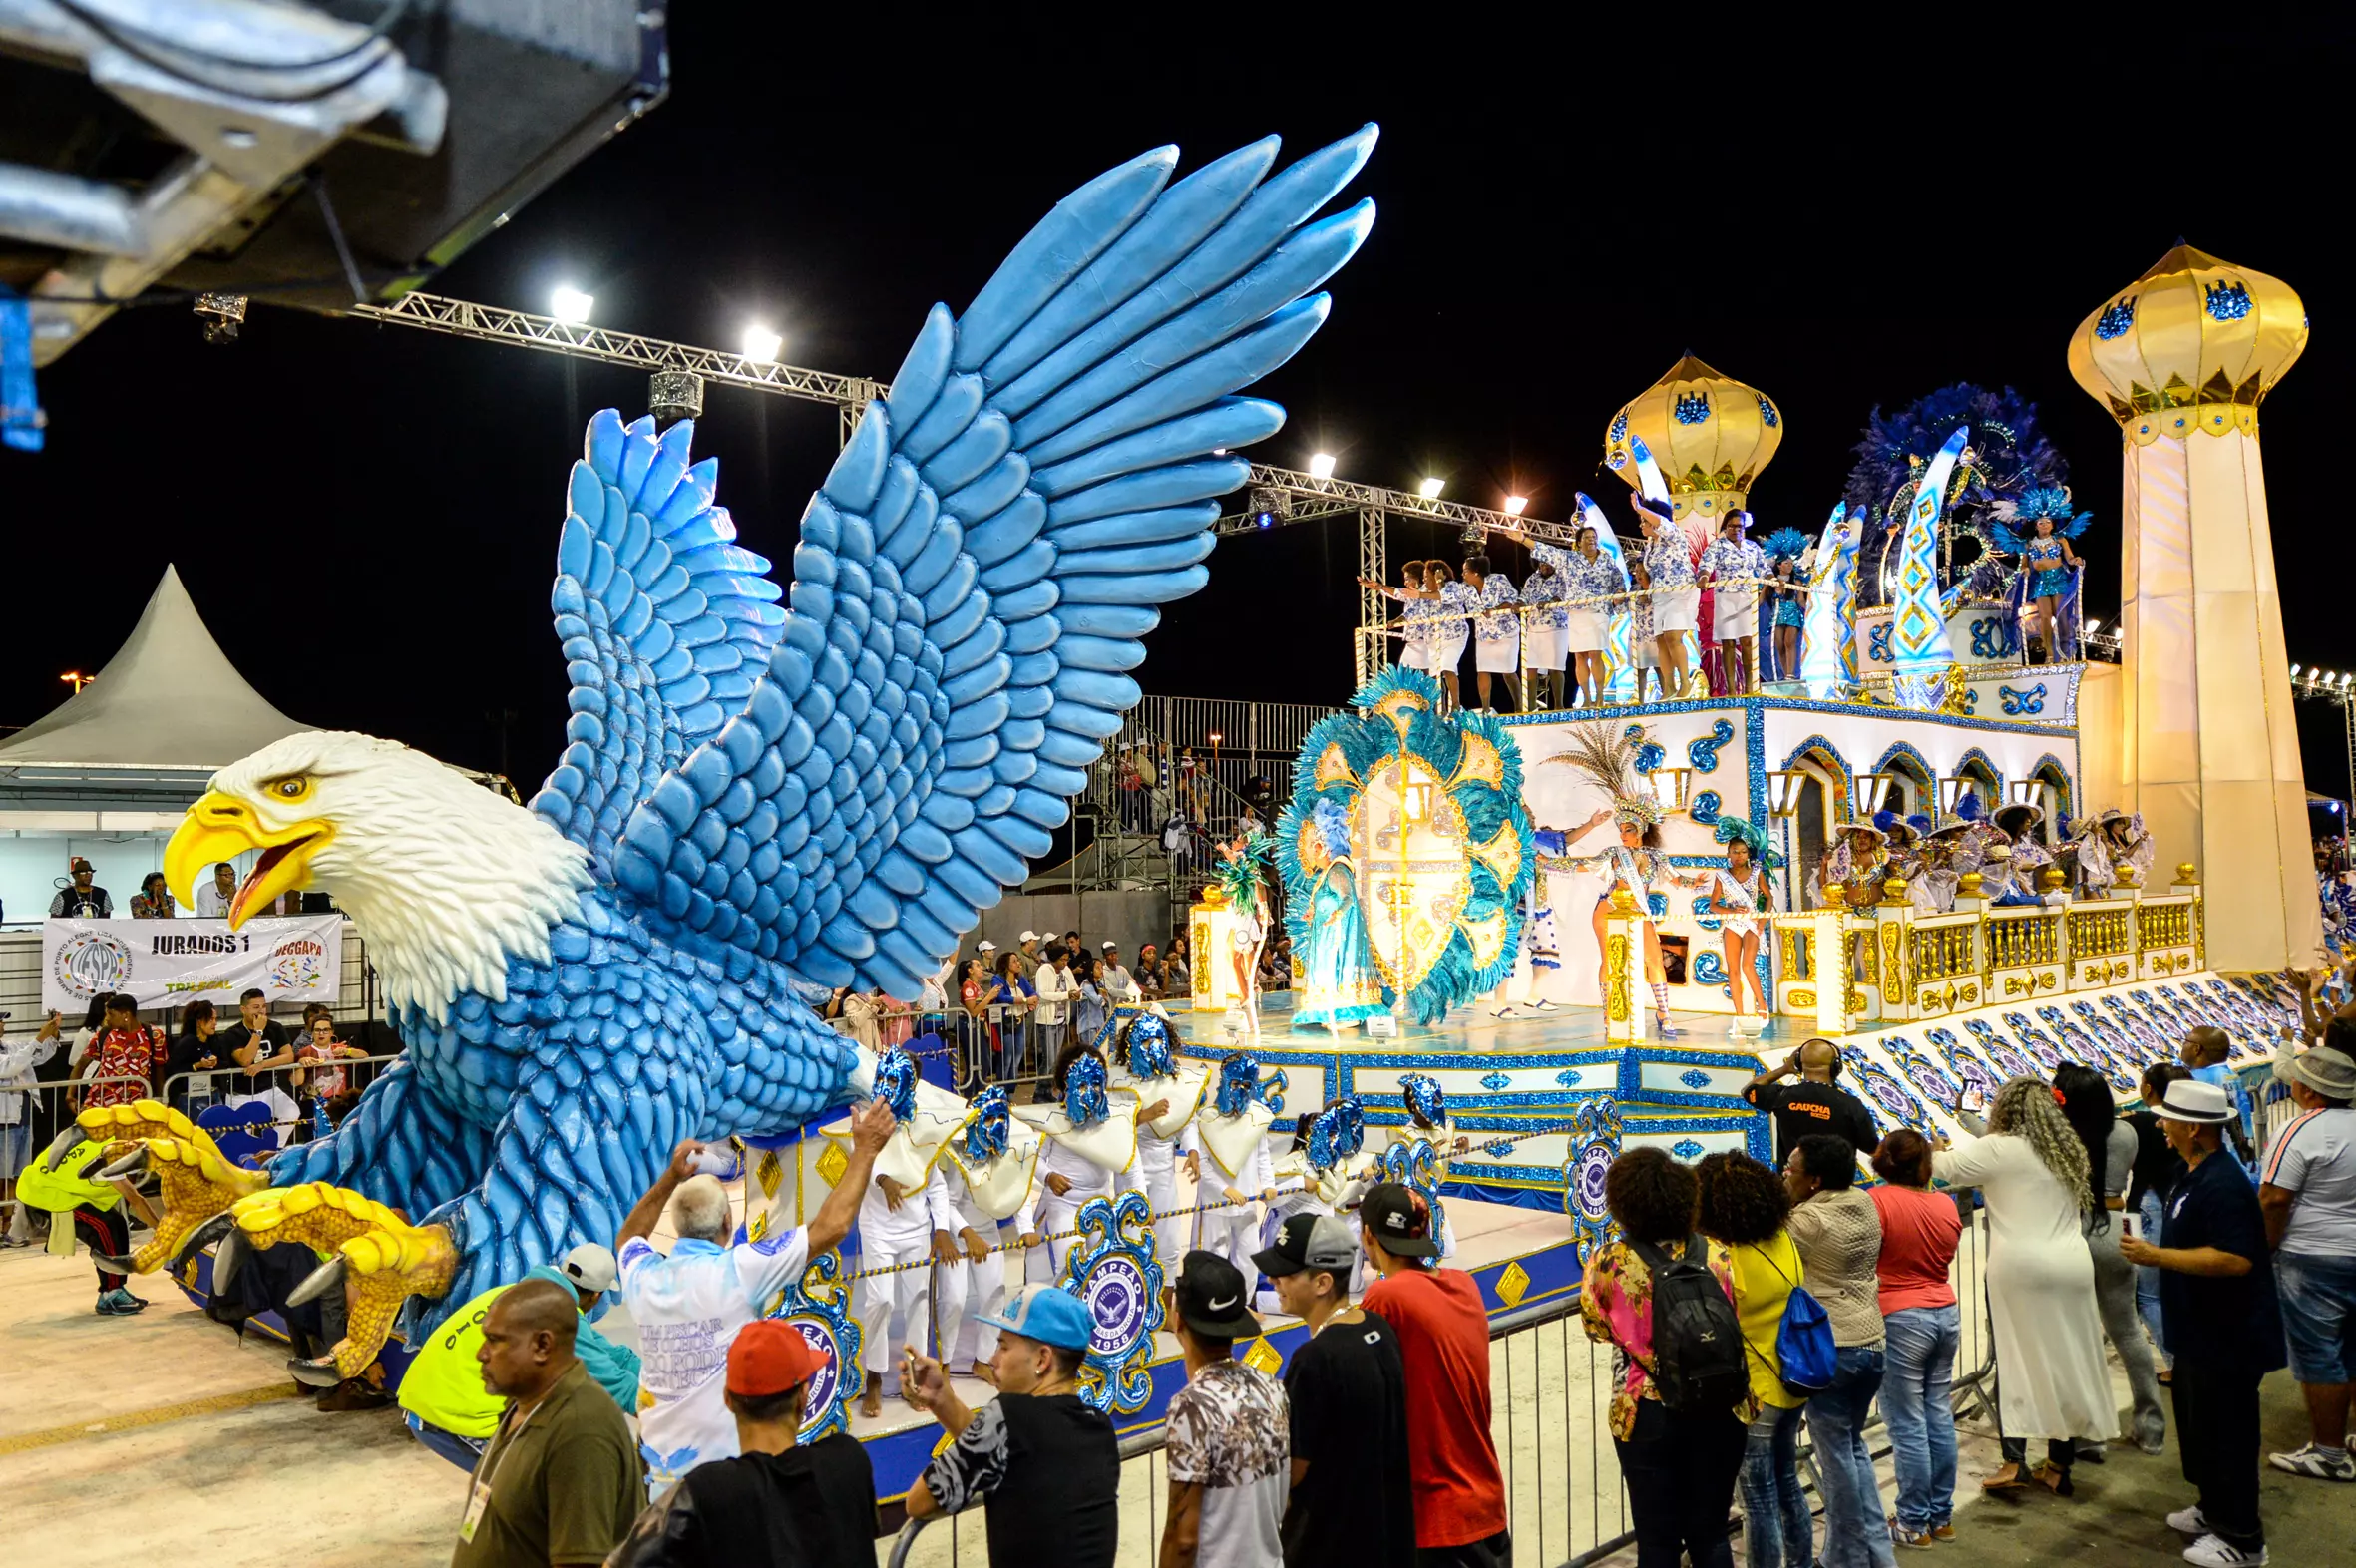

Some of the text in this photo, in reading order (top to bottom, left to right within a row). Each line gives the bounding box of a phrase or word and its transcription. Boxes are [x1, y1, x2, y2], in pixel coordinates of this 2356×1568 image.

[55, 943, 68, 965] PORTO
[152, 935, 236, 955] JURADOS
[240, 934, 249, 952] 1
[54, 967, 60, 976] DE
[56, 976, 73, 995] SAMBA
[1788, 1102, 1831, 1115] GAUCHA
[40, 1148, 85, 1174] APOO
[1082, 1263, 1142, 1303] CAMPEÃO
[445, 1306, 490, 1350] OIO
[1119, 1307, 1135, 1333] ORGIA
[1095, 1333, 1129, 1351] 1958
